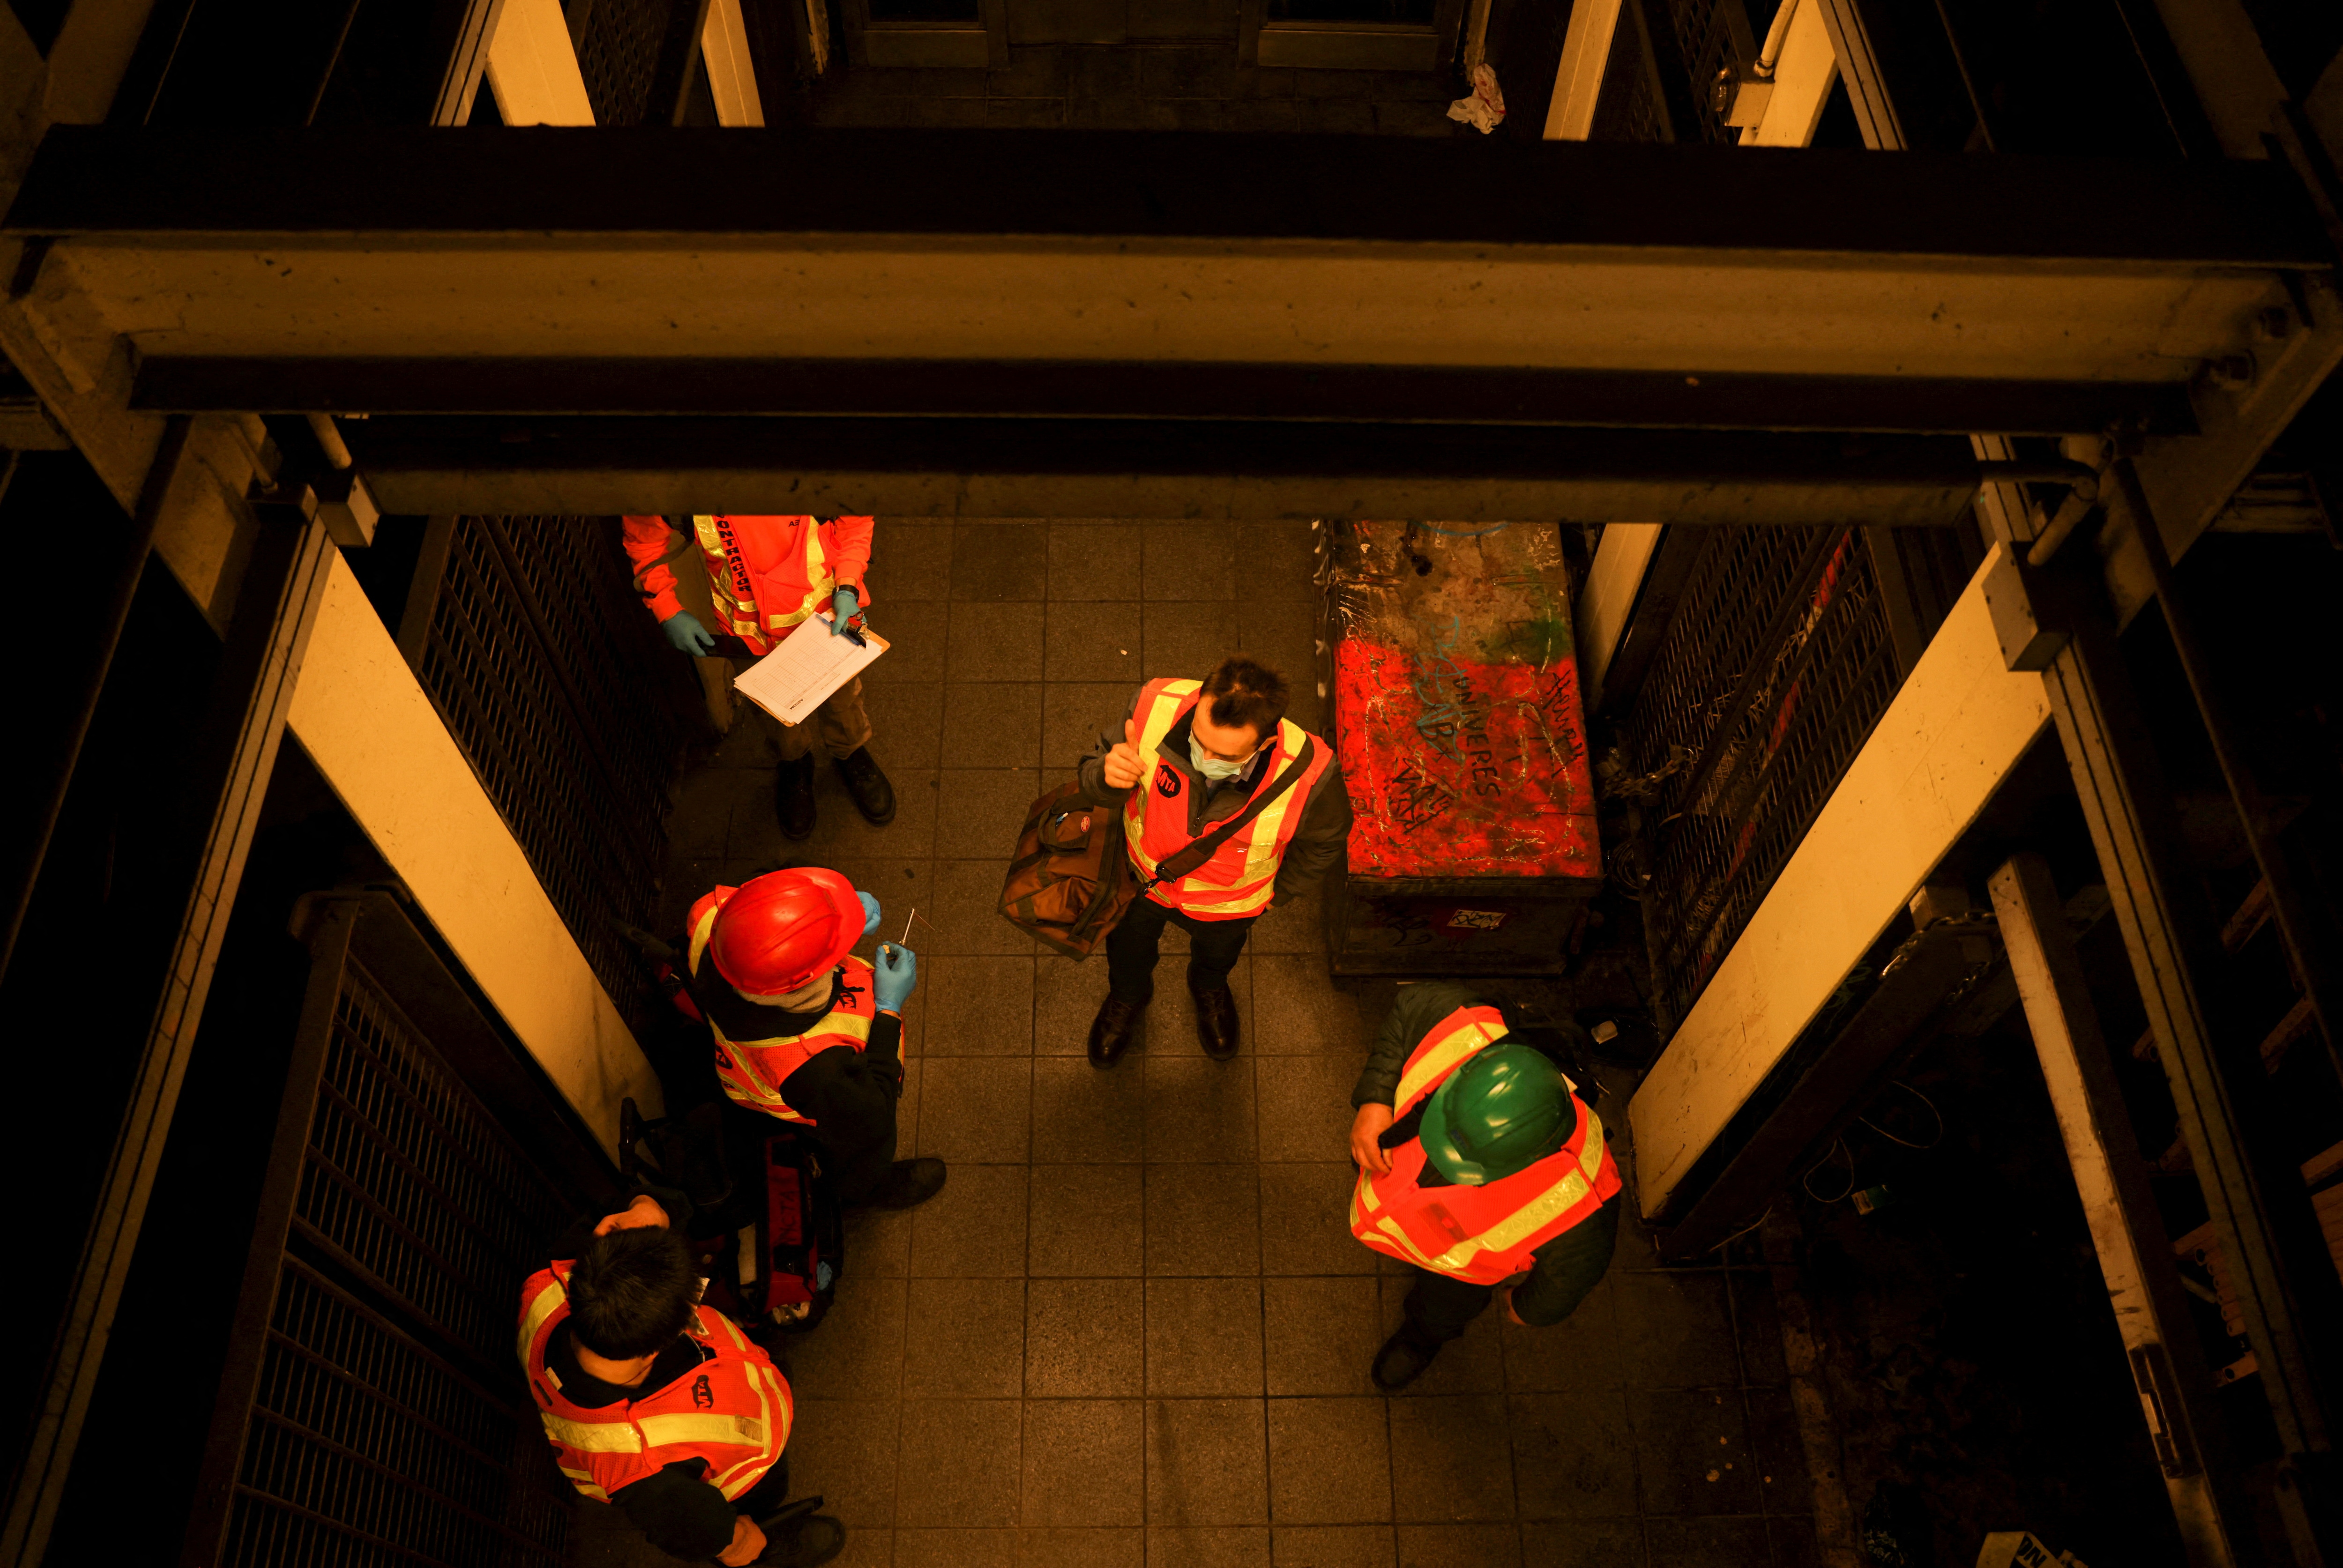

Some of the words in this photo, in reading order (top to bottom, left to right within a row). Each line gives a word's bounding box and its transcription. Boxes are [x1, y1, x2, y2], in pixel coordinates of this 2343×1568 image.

[790, 698, 803, 710] AECOM
[1157, 769, 1176, 793] MTA
[697, 1381, 711, 1409] MTA
